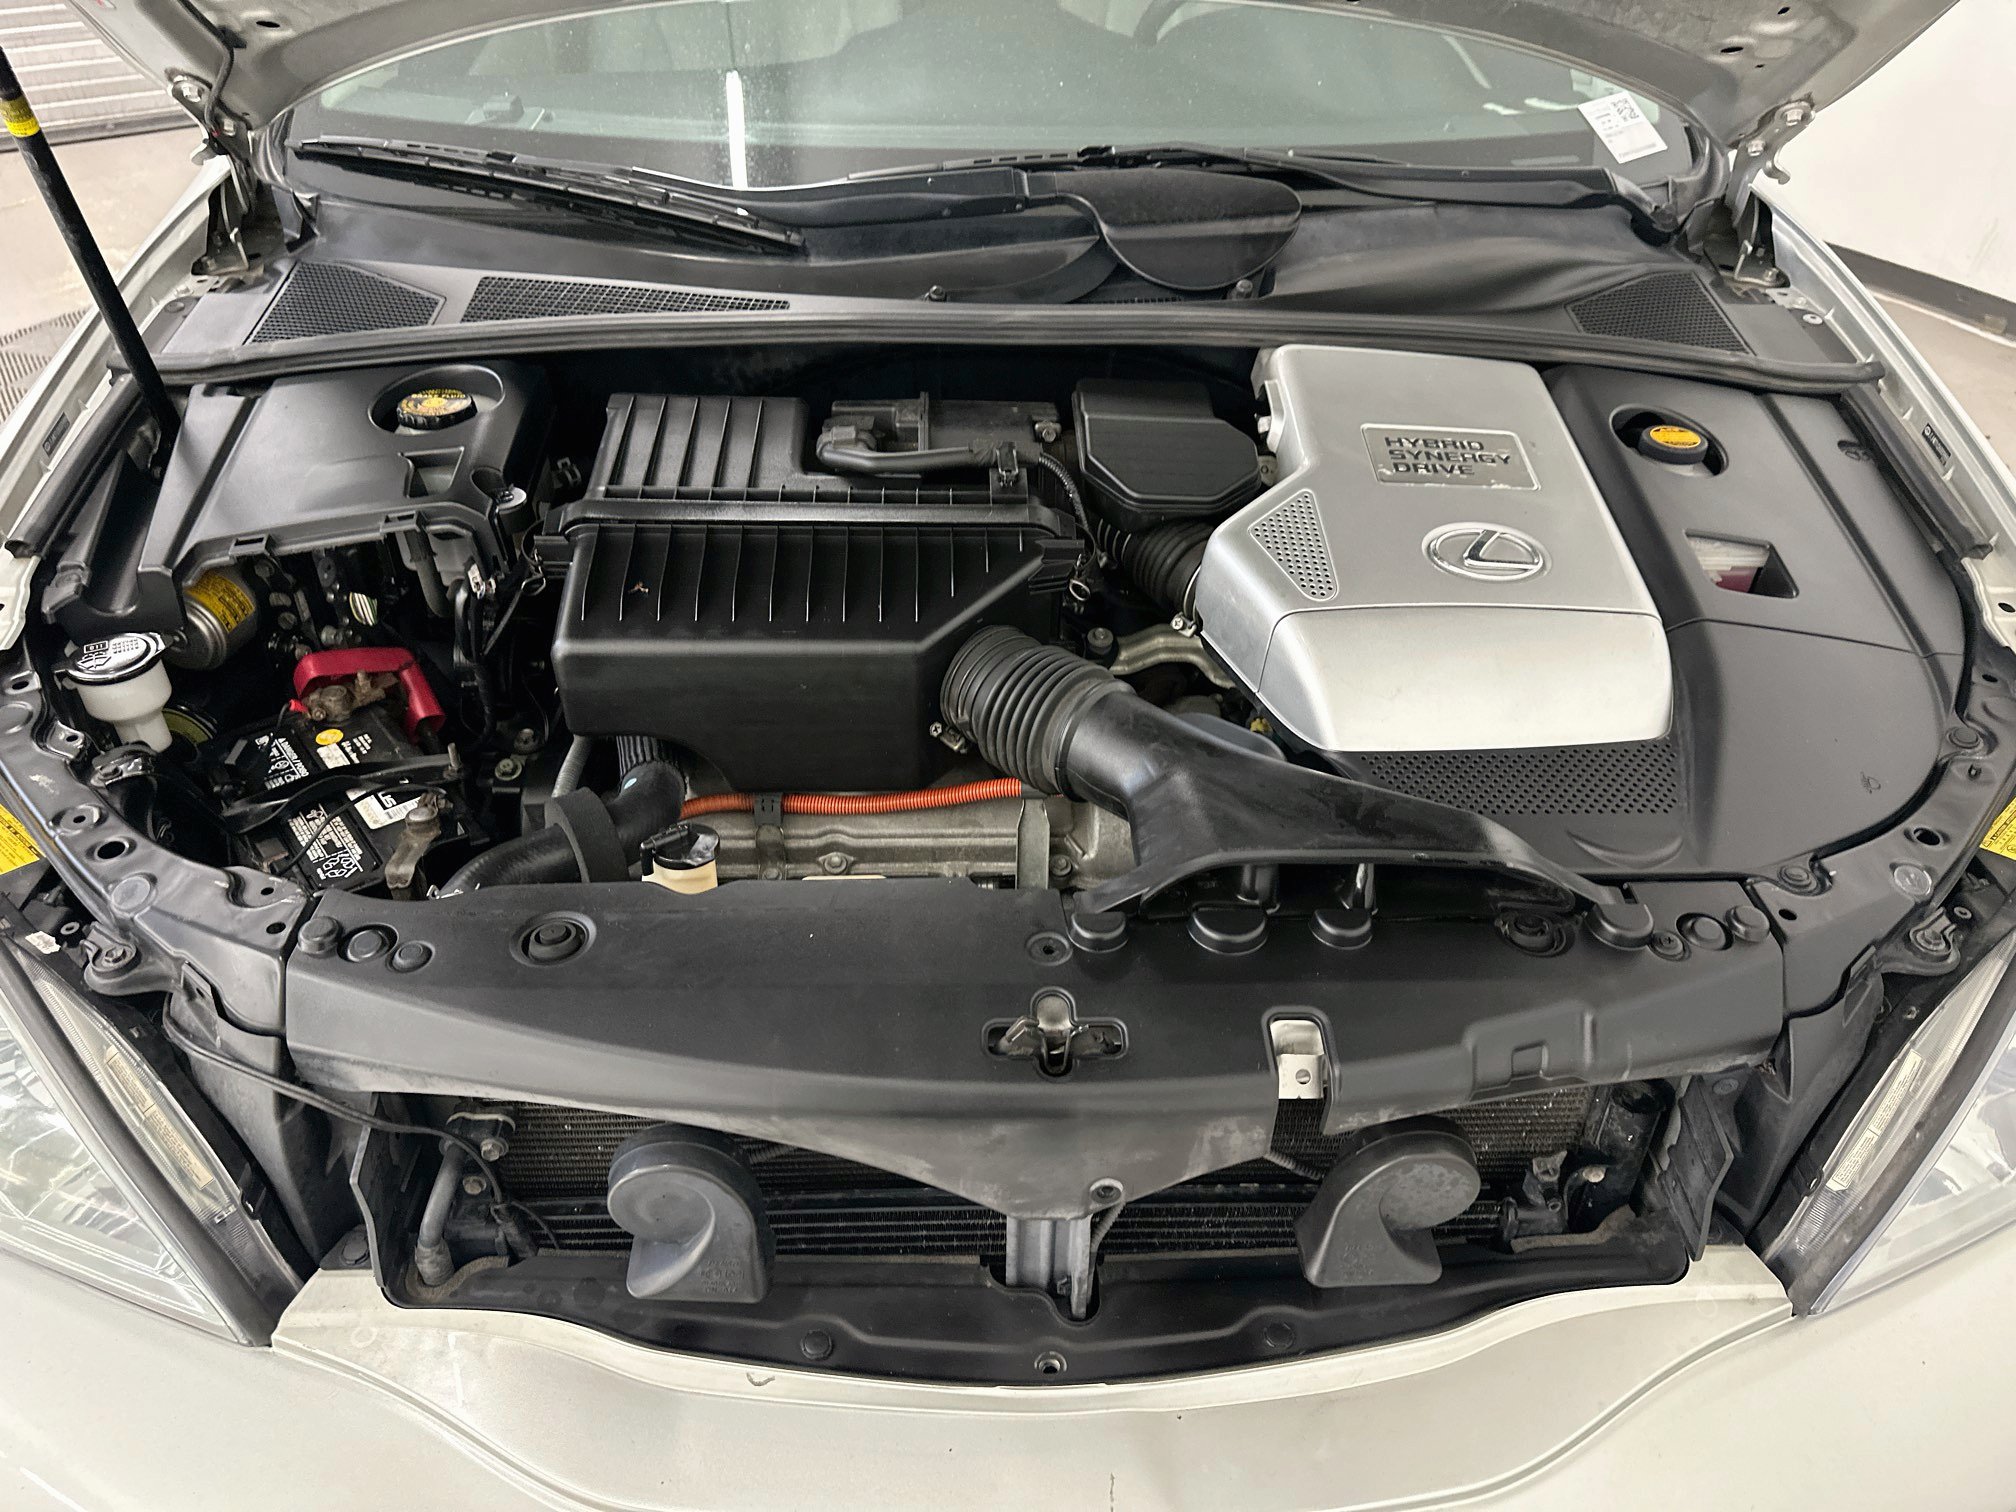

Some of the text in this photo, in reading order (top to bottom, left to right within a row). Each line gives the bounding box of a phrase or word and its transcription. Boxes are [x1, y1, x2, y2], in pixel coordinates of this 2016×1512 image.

[1384, 437, 1484, 451] HYBRID
[1388, 449, 1511, 465] SYNERGY
[1392, 461, 1475, 475] DRIVE
[377, 791, 397, 808] US
